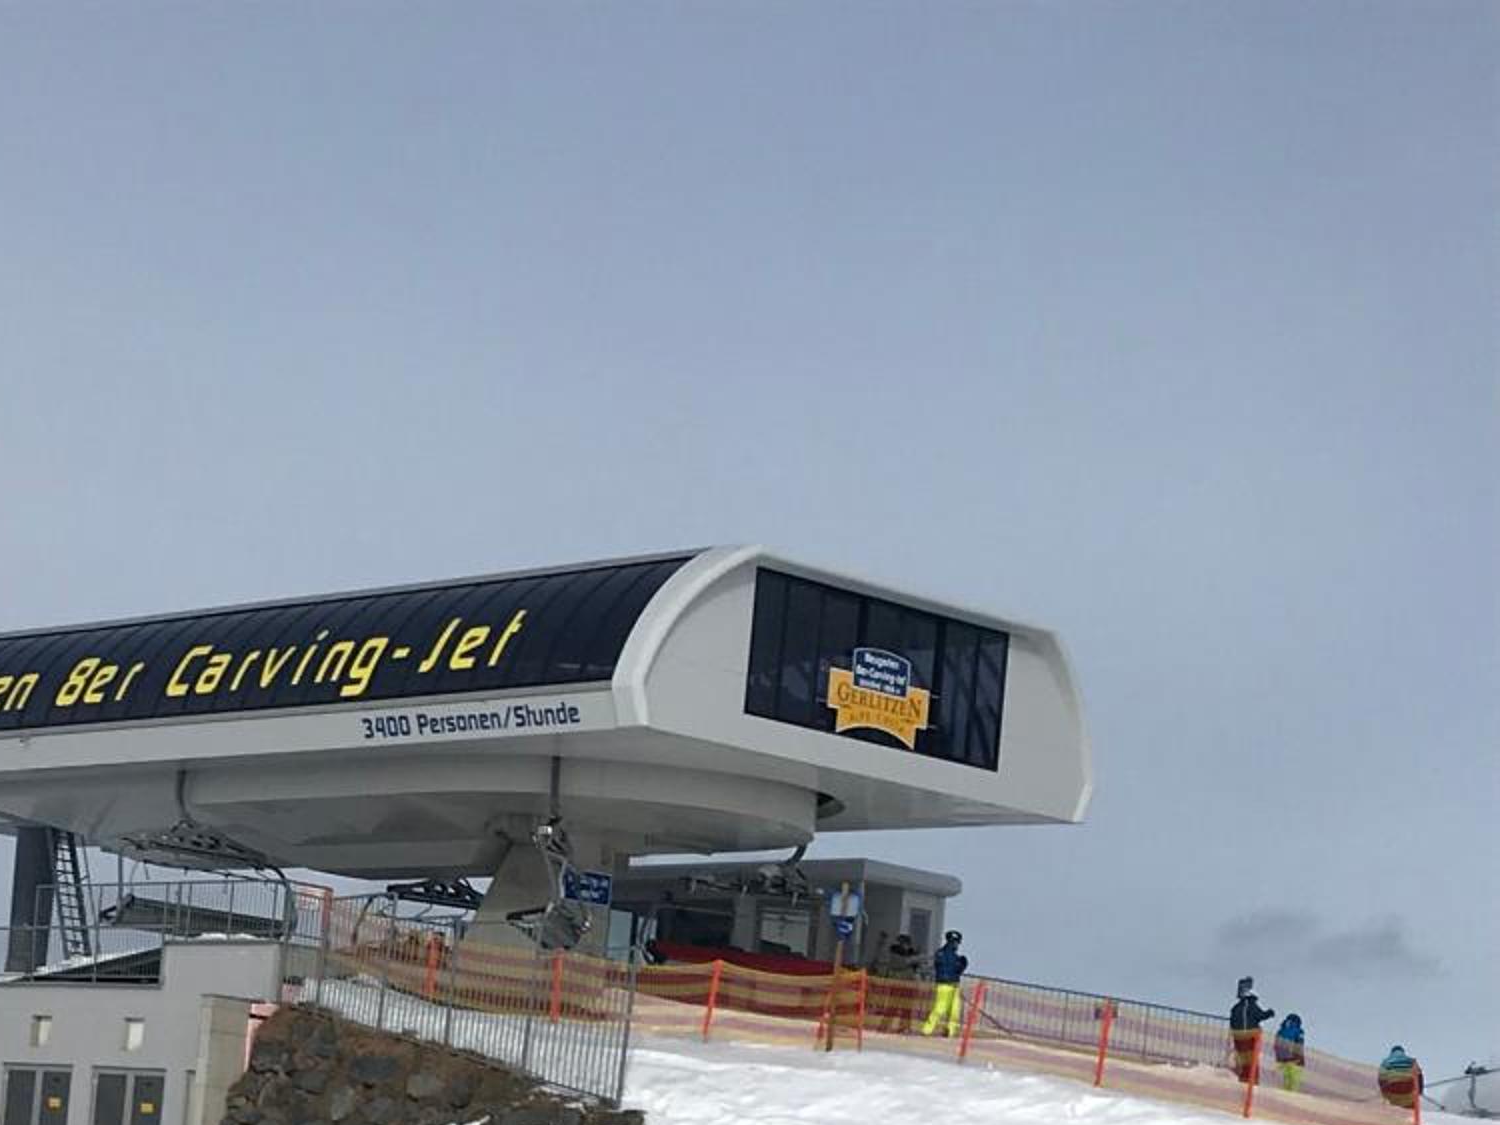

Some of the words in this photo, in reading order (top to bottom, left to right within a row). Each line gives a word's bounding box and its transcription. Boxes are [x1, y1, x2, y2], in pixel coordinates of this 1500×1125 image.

[55, 657, 145, 707] 8er
[165, 609, 528, 697] Carving-Jet
[837, 681, 923, 719] GERLITZEN
[361, 715, 411, 739] 3400
[415, 702, 581, 735] Personen/Stunde
